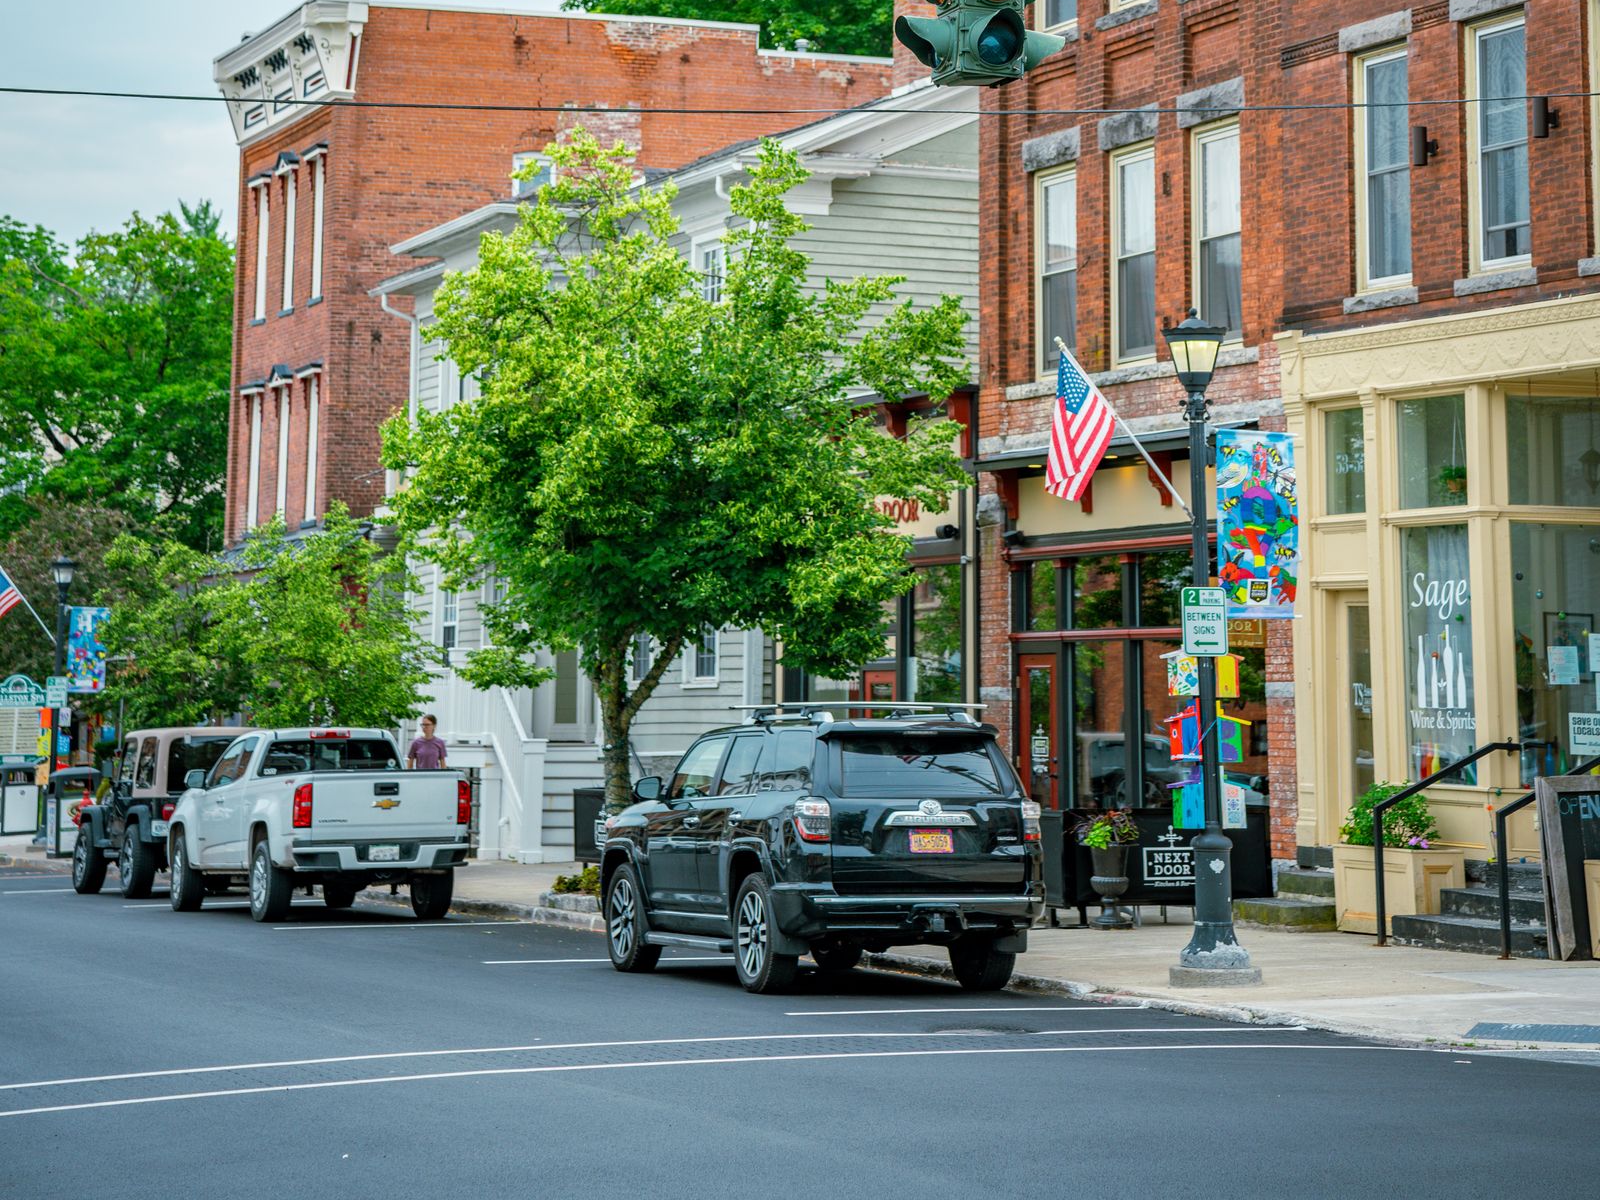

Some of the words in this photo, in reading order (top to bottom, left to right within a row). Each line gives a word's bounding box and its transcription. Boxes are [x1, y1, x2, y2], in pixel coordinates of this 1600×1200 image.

[1188, 590, 1196, 603] 2
[1411, 572, 1468, 620] Sage
[1186, 612, 1222, 621] BETWEEN
[1193, 625, 1216, 635] SIGNS
[1410, 710, 1435, 729] Wine
[1436, 710, 1446, 729] &
[1446, 710, 1476, 737] Spirits
[1559, 794, 1600, 819] OPEN
[1153, 852, 1191, 863] NEXT
[1154, 864, 1192, 876] DOOR
